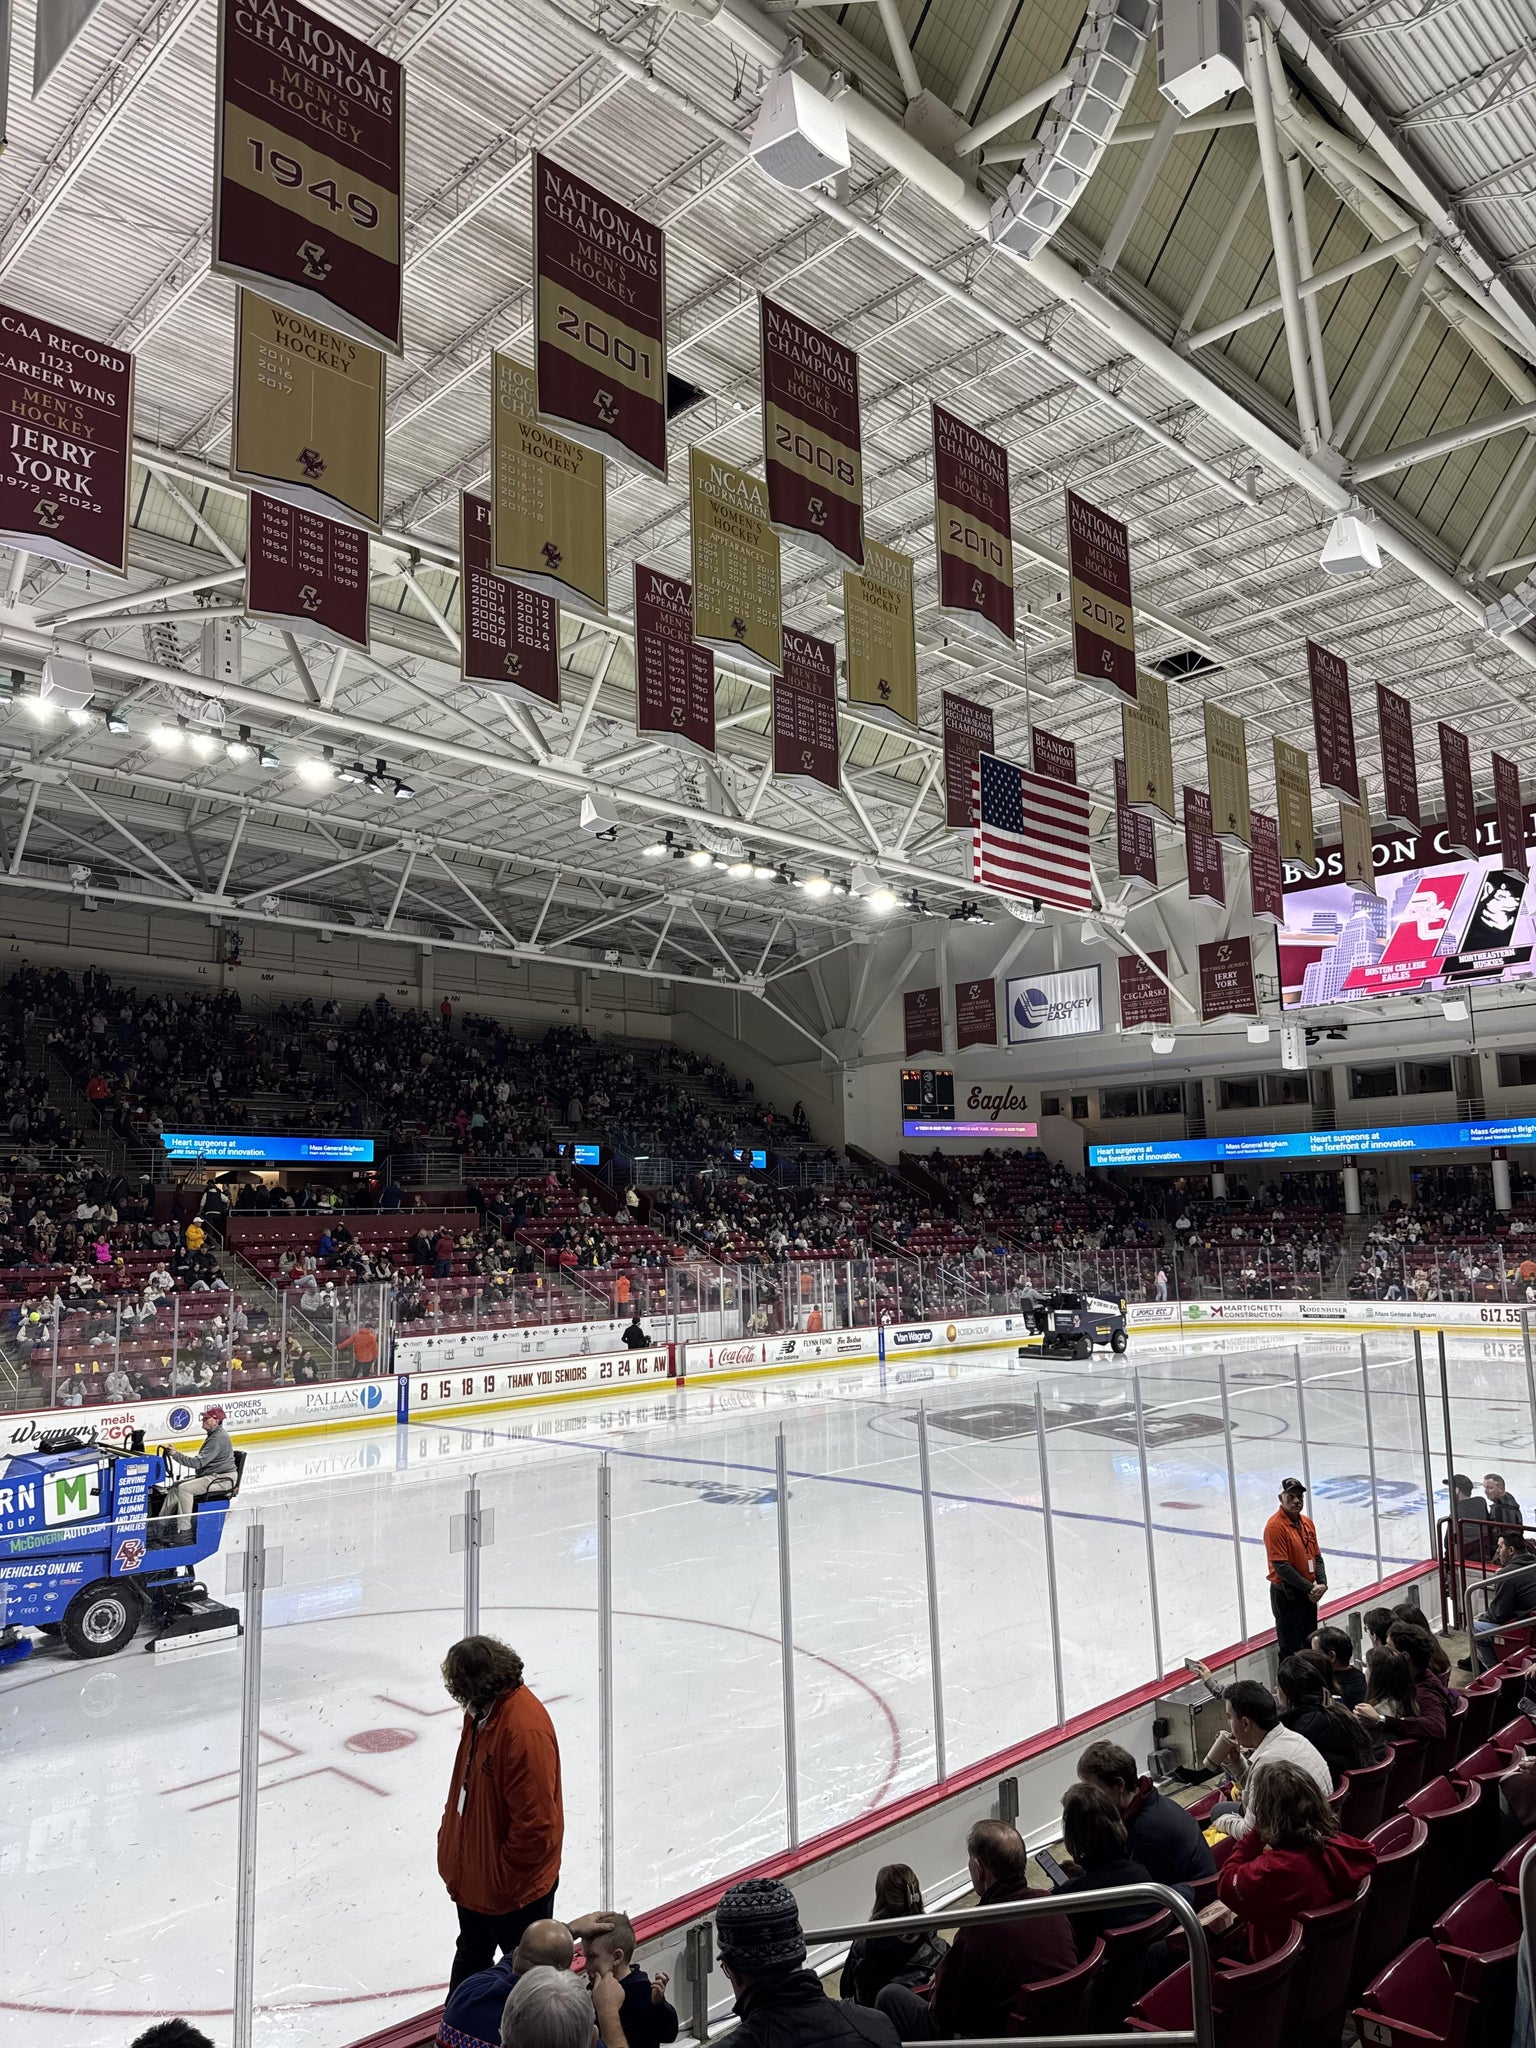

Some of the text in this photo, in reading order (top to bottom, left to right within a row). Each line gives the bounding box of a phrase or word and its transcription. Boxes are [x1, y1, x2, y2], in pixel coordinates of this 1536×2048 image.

[236, 0, 393, 95] NATIONAL
[235, 8, 392, 116] CHAMPIONS
[281, 65, 349, 117] MEN'S
[269, 79, 362, 145] HOCKEY
[247, 137, 379, 231] 1949
[544, 168, 657, 257] NATIONAL
[544, 195, 658, 275] CHAMPIONS
[577, 240, 627, 281] MEN'S
[569, 252, 637, 303] HOCKEY
[271, 309, 356, 360] WOMEN'S
[557, 304, 651, 380] 2001
[766, 308, 853, 377] NATIONAL
[39, 352, 73, 374] 1123
[48, 332, 124, 372] RECORD
[259, 345, 291, 366] 2011
[276, 329, 350, 373] HOCKEY
[766, 331, 854, 393] CHAMPIONS
[258, 359, 293, 380] 2016
[70, 379, 116, 406] WINS
[258, 374, 293, 394] 2017
[793, 367, 831, 399] MEN'S
[23, 387, 84, 420] MEN'S
[787, 379, 839, 420] HOCKEY
[11, 399, 95, 439] HOCKEY
[10, 423, 96, 468] JERRY
[518, 422, 584, 462] WOMEN'S
[775, 423, 855, 487] 2008
[937, 415, 1004, 472] NATIONAL
[521, 439, 580, 475] HOCKEY
[938, 434, 1004, 486] CHAMPIONS
[11, 452, 93, 496] YORK
[709, 463, 763, 507] NCAA
[958, 464, 988, 491] MEN'S
[0, 474, 101, 513] 1972 2022
[954, 475, 994, 509] HOCKEY
[710, 500, 762, 534] WOMEN'S
[1071, 500, 1125, 547] NATIONAL
[713, 516, 760, 546] HOCKEY
[949, 520, 1003, 567] 2010
[1071, 518, 1127, 561] CHAMPIONS
[1085, 556, 1118, 584] HOCKEY
[1088, 546, 1113, 569] MEN'S
[471, 573, 505, 593] 2000
[471, 584, 504, 604] 2001
[711, 576, 763, 605] FROZEN FOUR
[859, 576, 901, 604] WOMEN'S
[862, 590, 900, 616] HOCKEY
[1081, 595, 1126, 635] 2012
[783, 632, 824, 662] NCAA
[1315, 650, 1341, 679] NCAA
[787, 673, 823, 695] HOCKEY
[945, 699, 991, 724] HOCKEY EAST
[1211, 711, 1239, 736] SWEET
[945, 717, 992, 742] CHAMPIONS
[1442, 729, 1465, 752] SWEET
[1035, 733, 1074, 759] BEANPOT
[1037, 747, 1073, 768] CHAMPIONS
[1261, 818, 1276, 832] EAST
[1283, 838, 1418, 884] BOSON
[1364, 961, 1427, 976] BOSTON COLLEGE
[1458, 948, 1516, 963] NORTHEASTERN
[1472, 957, 1505, 969] HUSKIES
[1214, 971, 1238, 981] JERRY
[1215, 979, 1238, 989] YORK
[1381, 971, 1411, 982] EAGLES
[1049, 997, 1092, 1012] HOCKEY
[1123, 988, 1166, 1001] CEGLARSKI
[1047, 1010, 1073, 1021] EAST
[967, 1085, 1028, 1121] Eagles
[172, 1138, 192, 1146] Heart
[193, 1140, 227, 1148] surgeons
[1310, 1132, 1380, 1143] Heart surgeons at
[1489, 1126, 1516, 1134] General
[1108, 1154, 1136, 1162] forefront
[1145, 1152, 1182, 1160] innovation.
[1115, 1147, 1143, 1155] surgeons
[1263, 1140, 1288, 1148] Brigham
[1310, 1140, 1416, 1152] the forefront of innovation.
[1413, 1311, 1436, 1319] Brigham
[803, 1338, 832, 1348] FLYNN FUND
[895, 1330, 932, 1343] Van Wagner
[421, 1382, 428, 1400] 8
[439, 1380, 451, 1398] 15
[462, 1378, 473, 1395] 18
[483, 1375, 495, 1393] 19
[507, 1372, 533, 1389] THANK
[537, 1370, 553, 1385] YOU
[555, 1367, 587, 1382] SENIORS
[600, 1362, 612, 1378] 23
[618, 1360, 631, 1376] 24
[636, 1358, 648, 1374] KC
[653, 1356, 667, 1372] AW
[224, 1399, 262, 1410] WORKERS
[305, 1388, 359, 1407] PALLAS
[305, 1402, 358, 1413] CAPITAL ADVISORS
[101, 1412, 135, 1426] meals
[234, 1407, 268, 1418] COUNCIL
[8, 1420, 98, 1450] Wegmans
[101, 1424, 135, 1441] 2GO
[118, 1475, 146, 1486] SERVING
[119, 1485, 145, 1496] BOSTON
[56, 1473, 88, 1516] M
[117, 1494, 146, 1505] COLLEGE
[114, 1512, 147, 1524] AND THEIR
[118, 1504, 144, 1514] ALUMNI
[116, 1523, 146, 1534] FAMILIES
[0, 1561, 84, 1580] VEHICLES ONLINE.
[1374, 2024, 1384, 2042] 4
